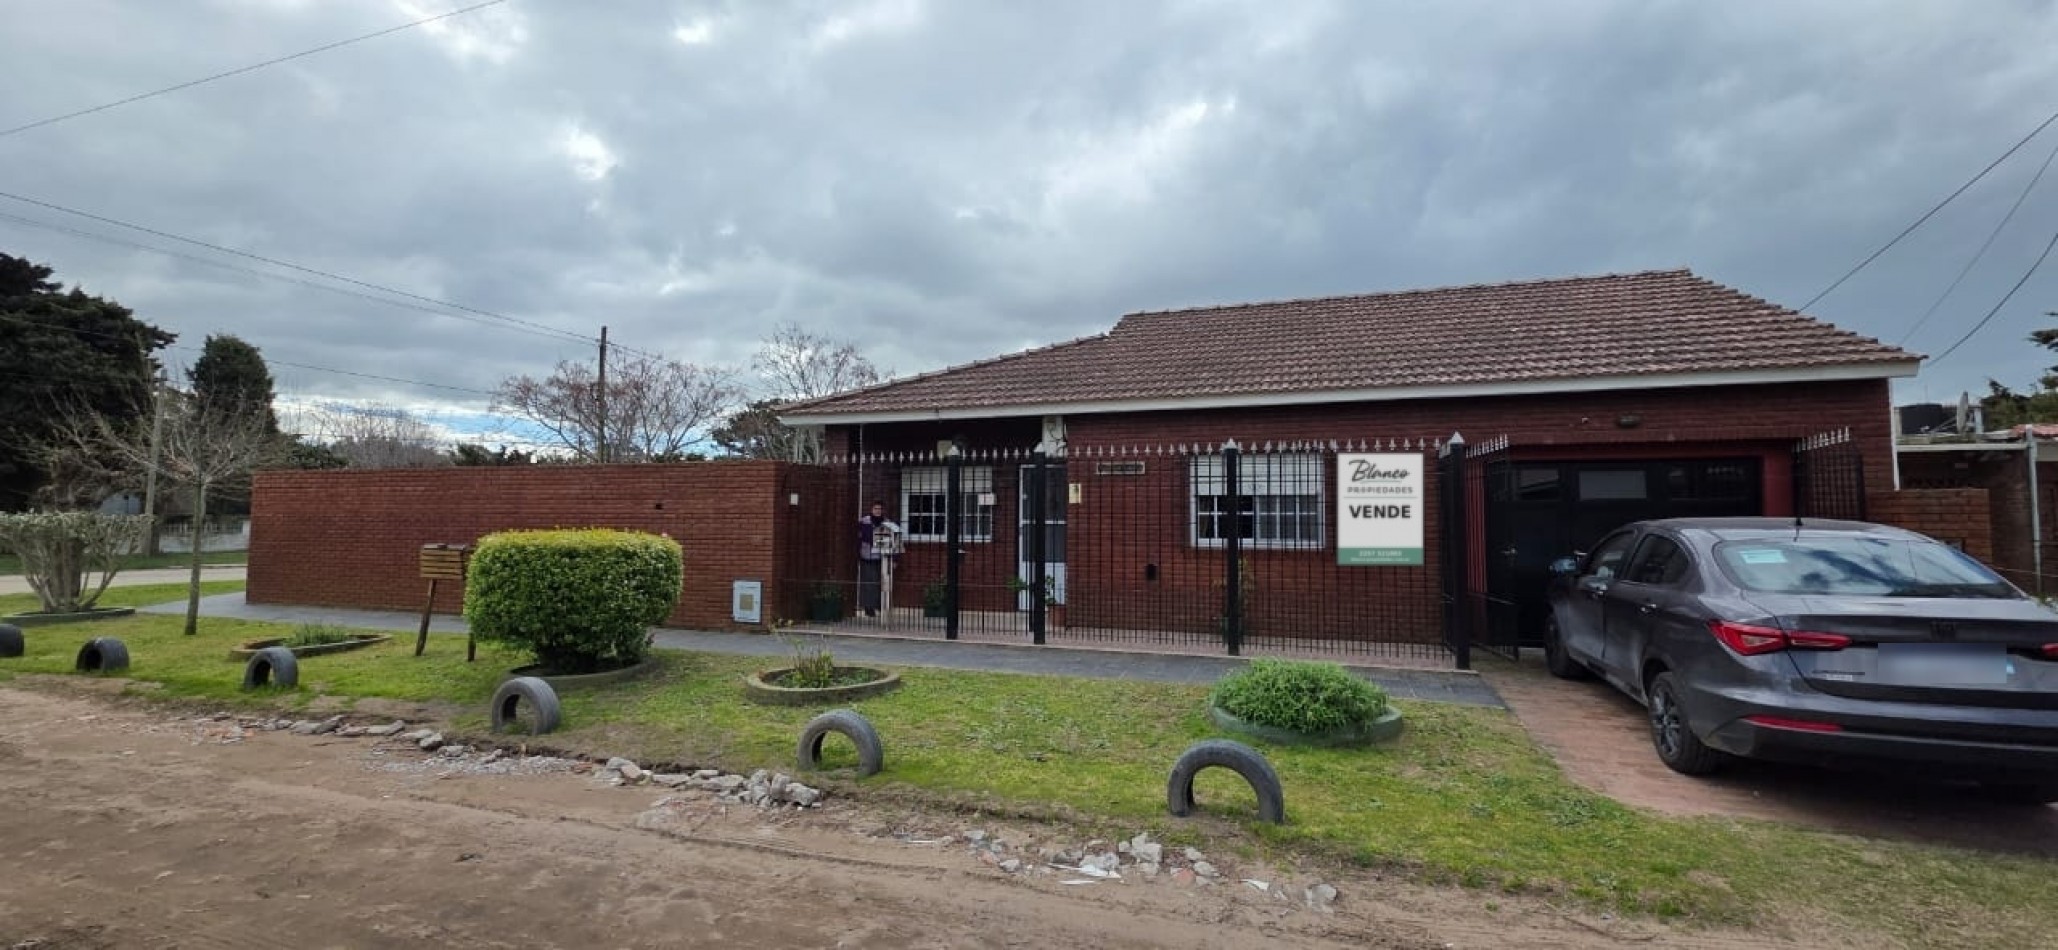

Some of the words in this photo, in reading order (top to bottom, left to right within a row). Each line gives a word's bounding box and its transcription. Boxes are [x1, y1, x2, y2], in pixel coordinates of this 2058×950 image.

[1348, 458, 1411, 482] Blanco
[1346, 486, 1413, 494] PROPIEDADES
[1349, 505, 1411, 519] VENDE
